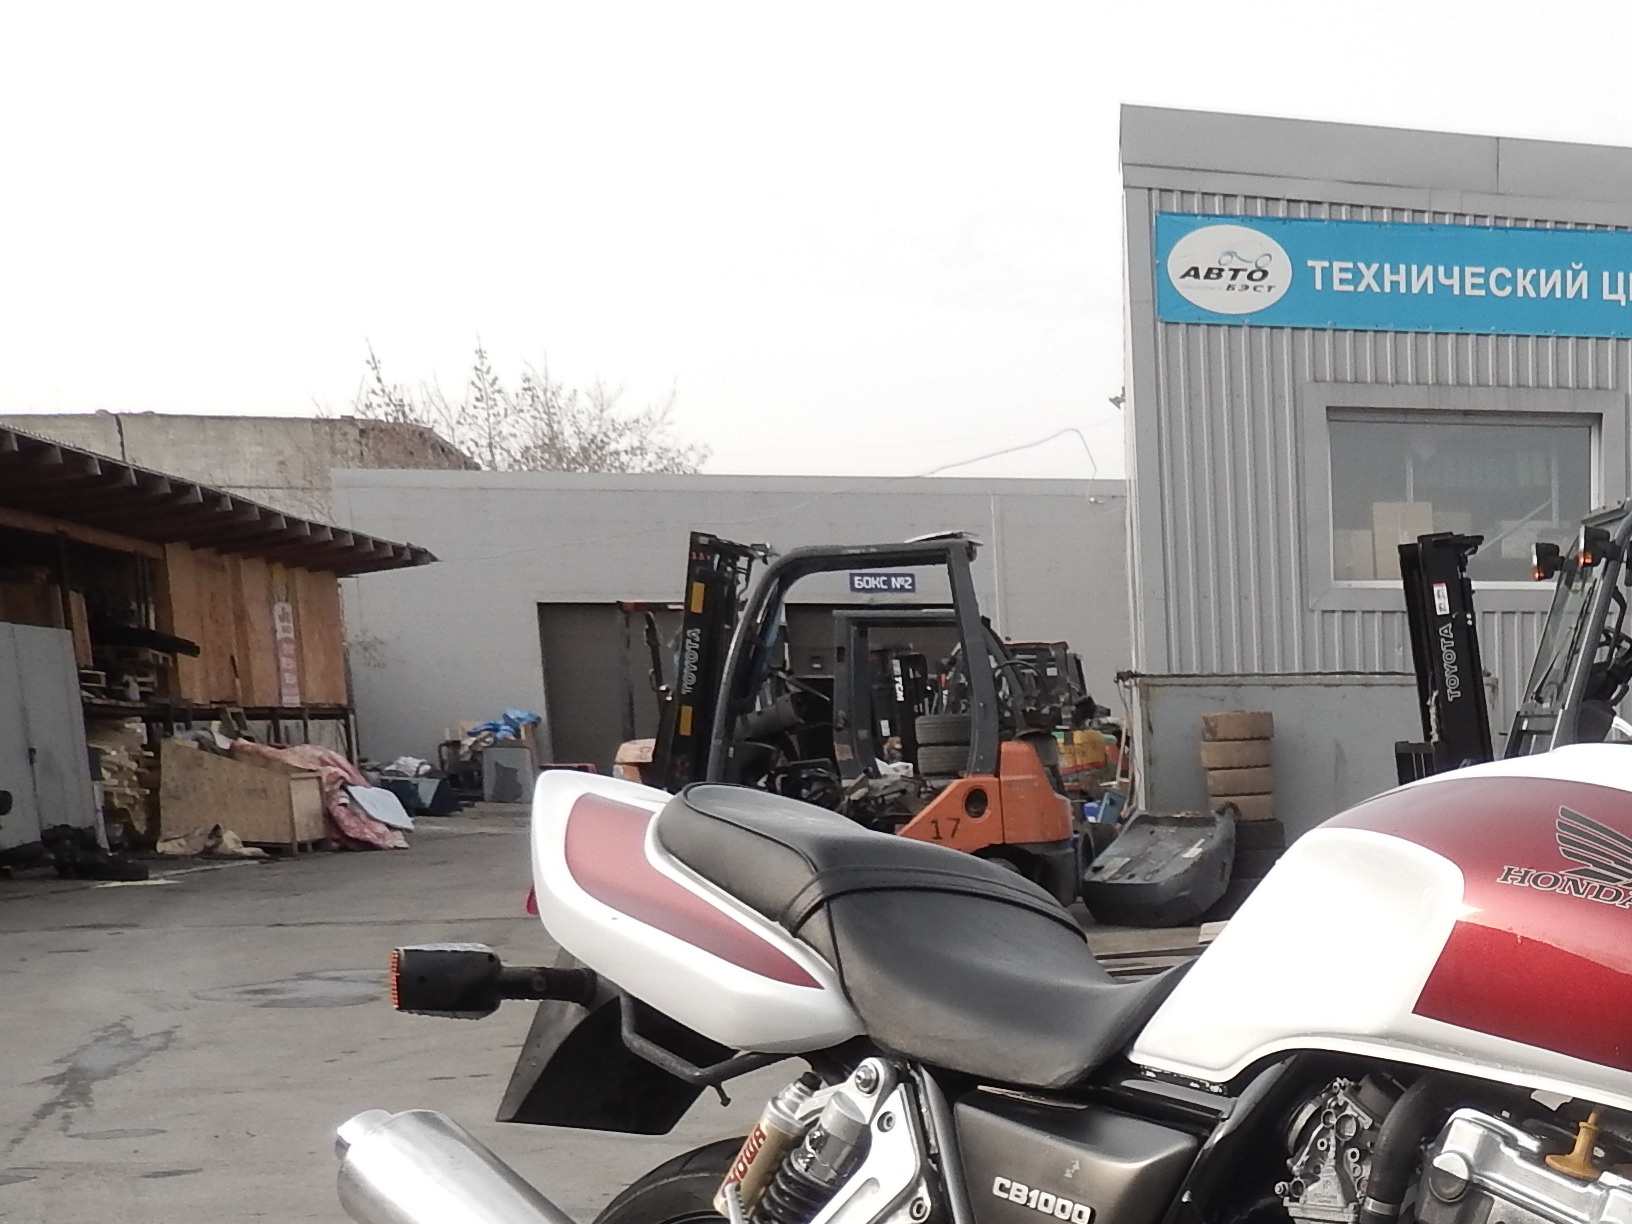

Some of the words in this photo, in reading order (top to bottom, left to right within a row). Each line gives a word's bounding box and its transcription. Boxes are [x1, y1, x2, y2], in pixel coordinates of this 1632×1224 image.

[1179, 266, 1269, 282] АВТО
[1307, 260, 1588, 300] ТЕХНИЧЕСКИЙ
[854, 576, 888, 589] БОКС
[682, 628, 701, 695] TOYOTA
[1439, 623, 1461, 702] TOYOTA
[931, 817, 961, 840] 17
